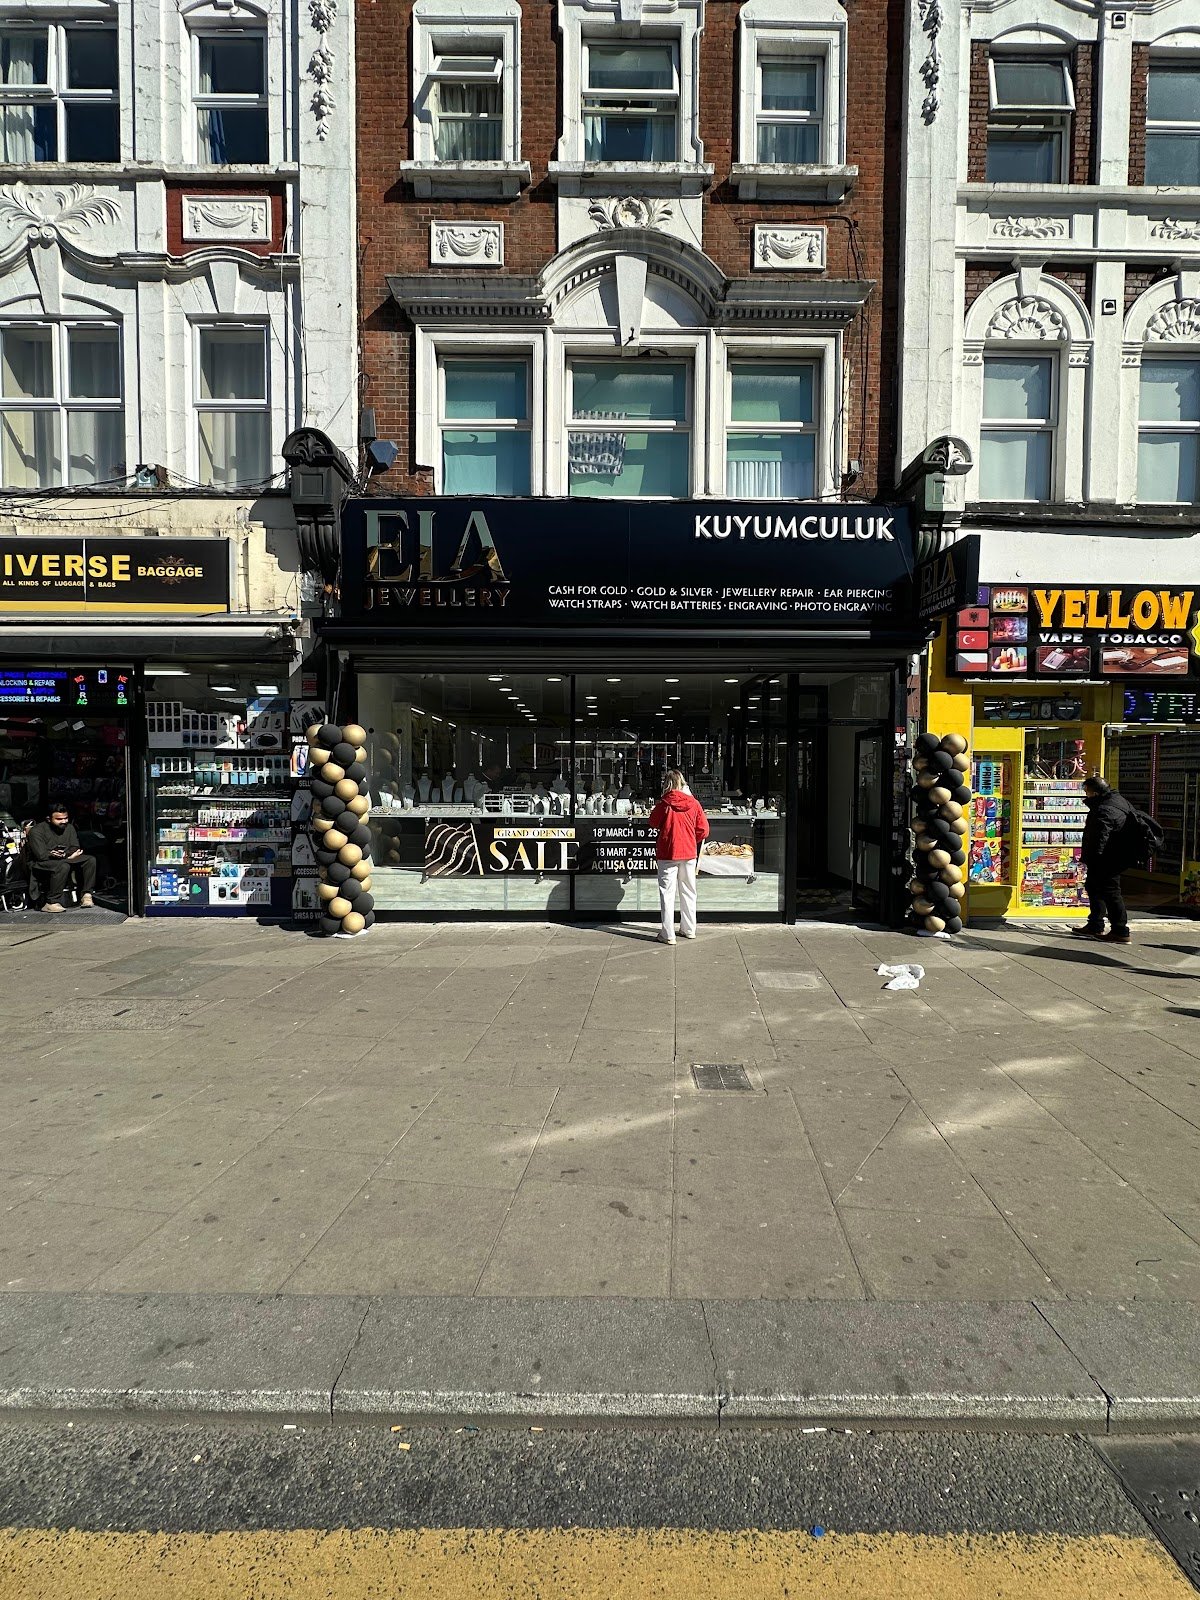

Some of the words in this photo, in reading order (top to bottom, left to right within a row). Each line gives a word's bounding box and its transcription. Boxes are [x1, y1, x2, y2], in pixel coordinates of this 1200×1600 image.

[695, 515, 896, 541] KUYUMCULUK
[364, 510, 511, 583] ELA
[4, 554, 131, 581] IVERSE
[137, 566, 204, 578] BAGGAGE
[363, 588, 511, 610] JEWELLERY
[548, 586, 575, 595] CASH
[577, 586, 597, 595] FOR
[600, 586, 628, 595] GOLD
[636, 587, 667, 596] GOLD
[669, 587, 678, 596] &
[680, 587, 713, 597] SILVER
[721, 588, 777, 599] JEWELLERY
[780, 588, 814, 598] REPAIR
[824, 589, 843, 598] EAR
[846, 589, 893, 599] PIERCING
[548, 599, 585, 609] WATCH
[586, 599, 622, 609] STRAPS
[631, 600, 668, 610] WATCH
[670, 600, 722, 610] BATTERIES
[728, 601, 788, 611] ENGRAVING
[794, 602, 832, 611] PHOTO
[833, 602, 893, 612] ENGRAVING
[1032, 590, 1195, 631] YELLOW
[1039, 633, 1084, 644] VAPE
[1097, 633, 1184, 645] TOBACCO
[982, 766, 992, 790] PRIME
[497, 829, 529, 837] GRAND
[532, 829, 573, 837] OPENING
[605, 827, 634, 838] MARCH
[489, 840, 580, 872] SALE
[595, 847, 605, 857] 18
[606, 847, 628, 857] MART
[632, 847, 642, 857] 25
[627, 857, 648, 870] ÖZEL
